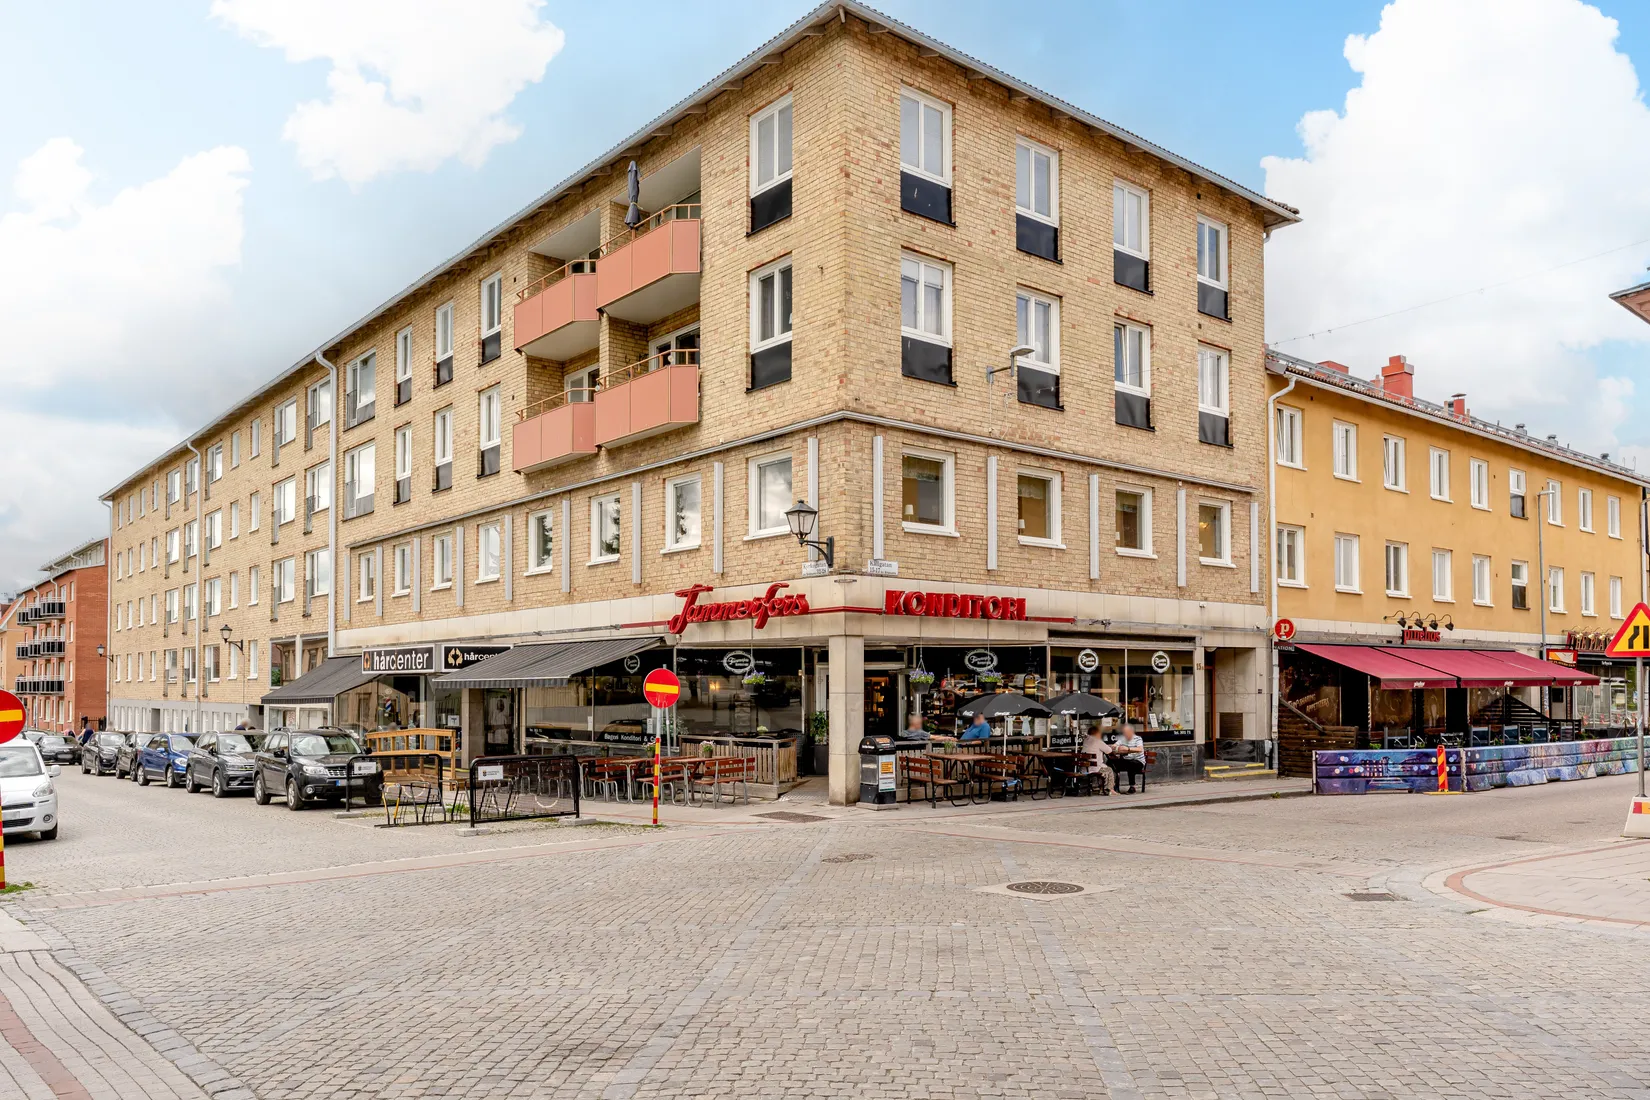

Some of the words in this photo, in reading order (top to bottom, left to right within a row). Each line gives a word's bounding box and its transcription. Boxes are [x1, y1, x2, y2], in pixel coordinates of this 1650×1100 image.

[669, 582, 810, 634] Tammerfors
[885, 590, 1026, 620] KONDITORI
[373, 651, 429, 670] hårcenter
[621, 734, 641, 742] Konditori
[1051, 736, 1071, 745] Bageri
